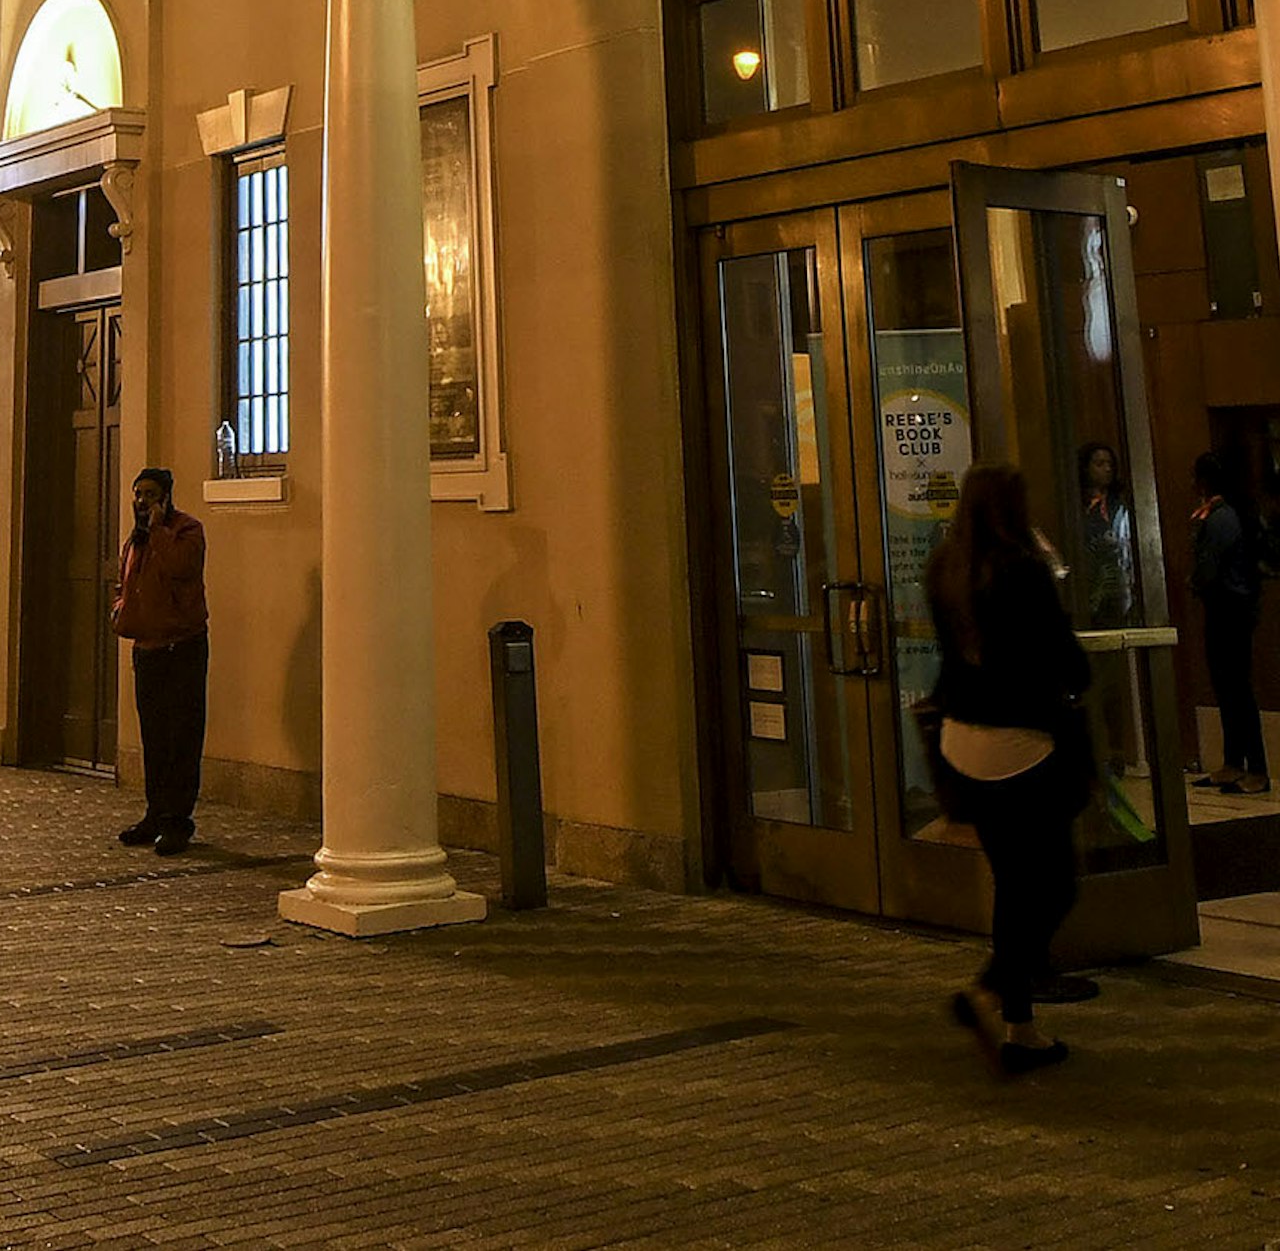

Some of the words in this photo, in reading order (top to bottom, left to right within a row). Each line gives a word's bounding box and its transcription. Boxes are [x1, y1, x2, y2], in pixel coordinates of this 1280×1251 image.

[885, 412, 953, 427] REESE'S
[896, 427, 943, 442] BOOK
[899, 442, 942, 456] CLUB
